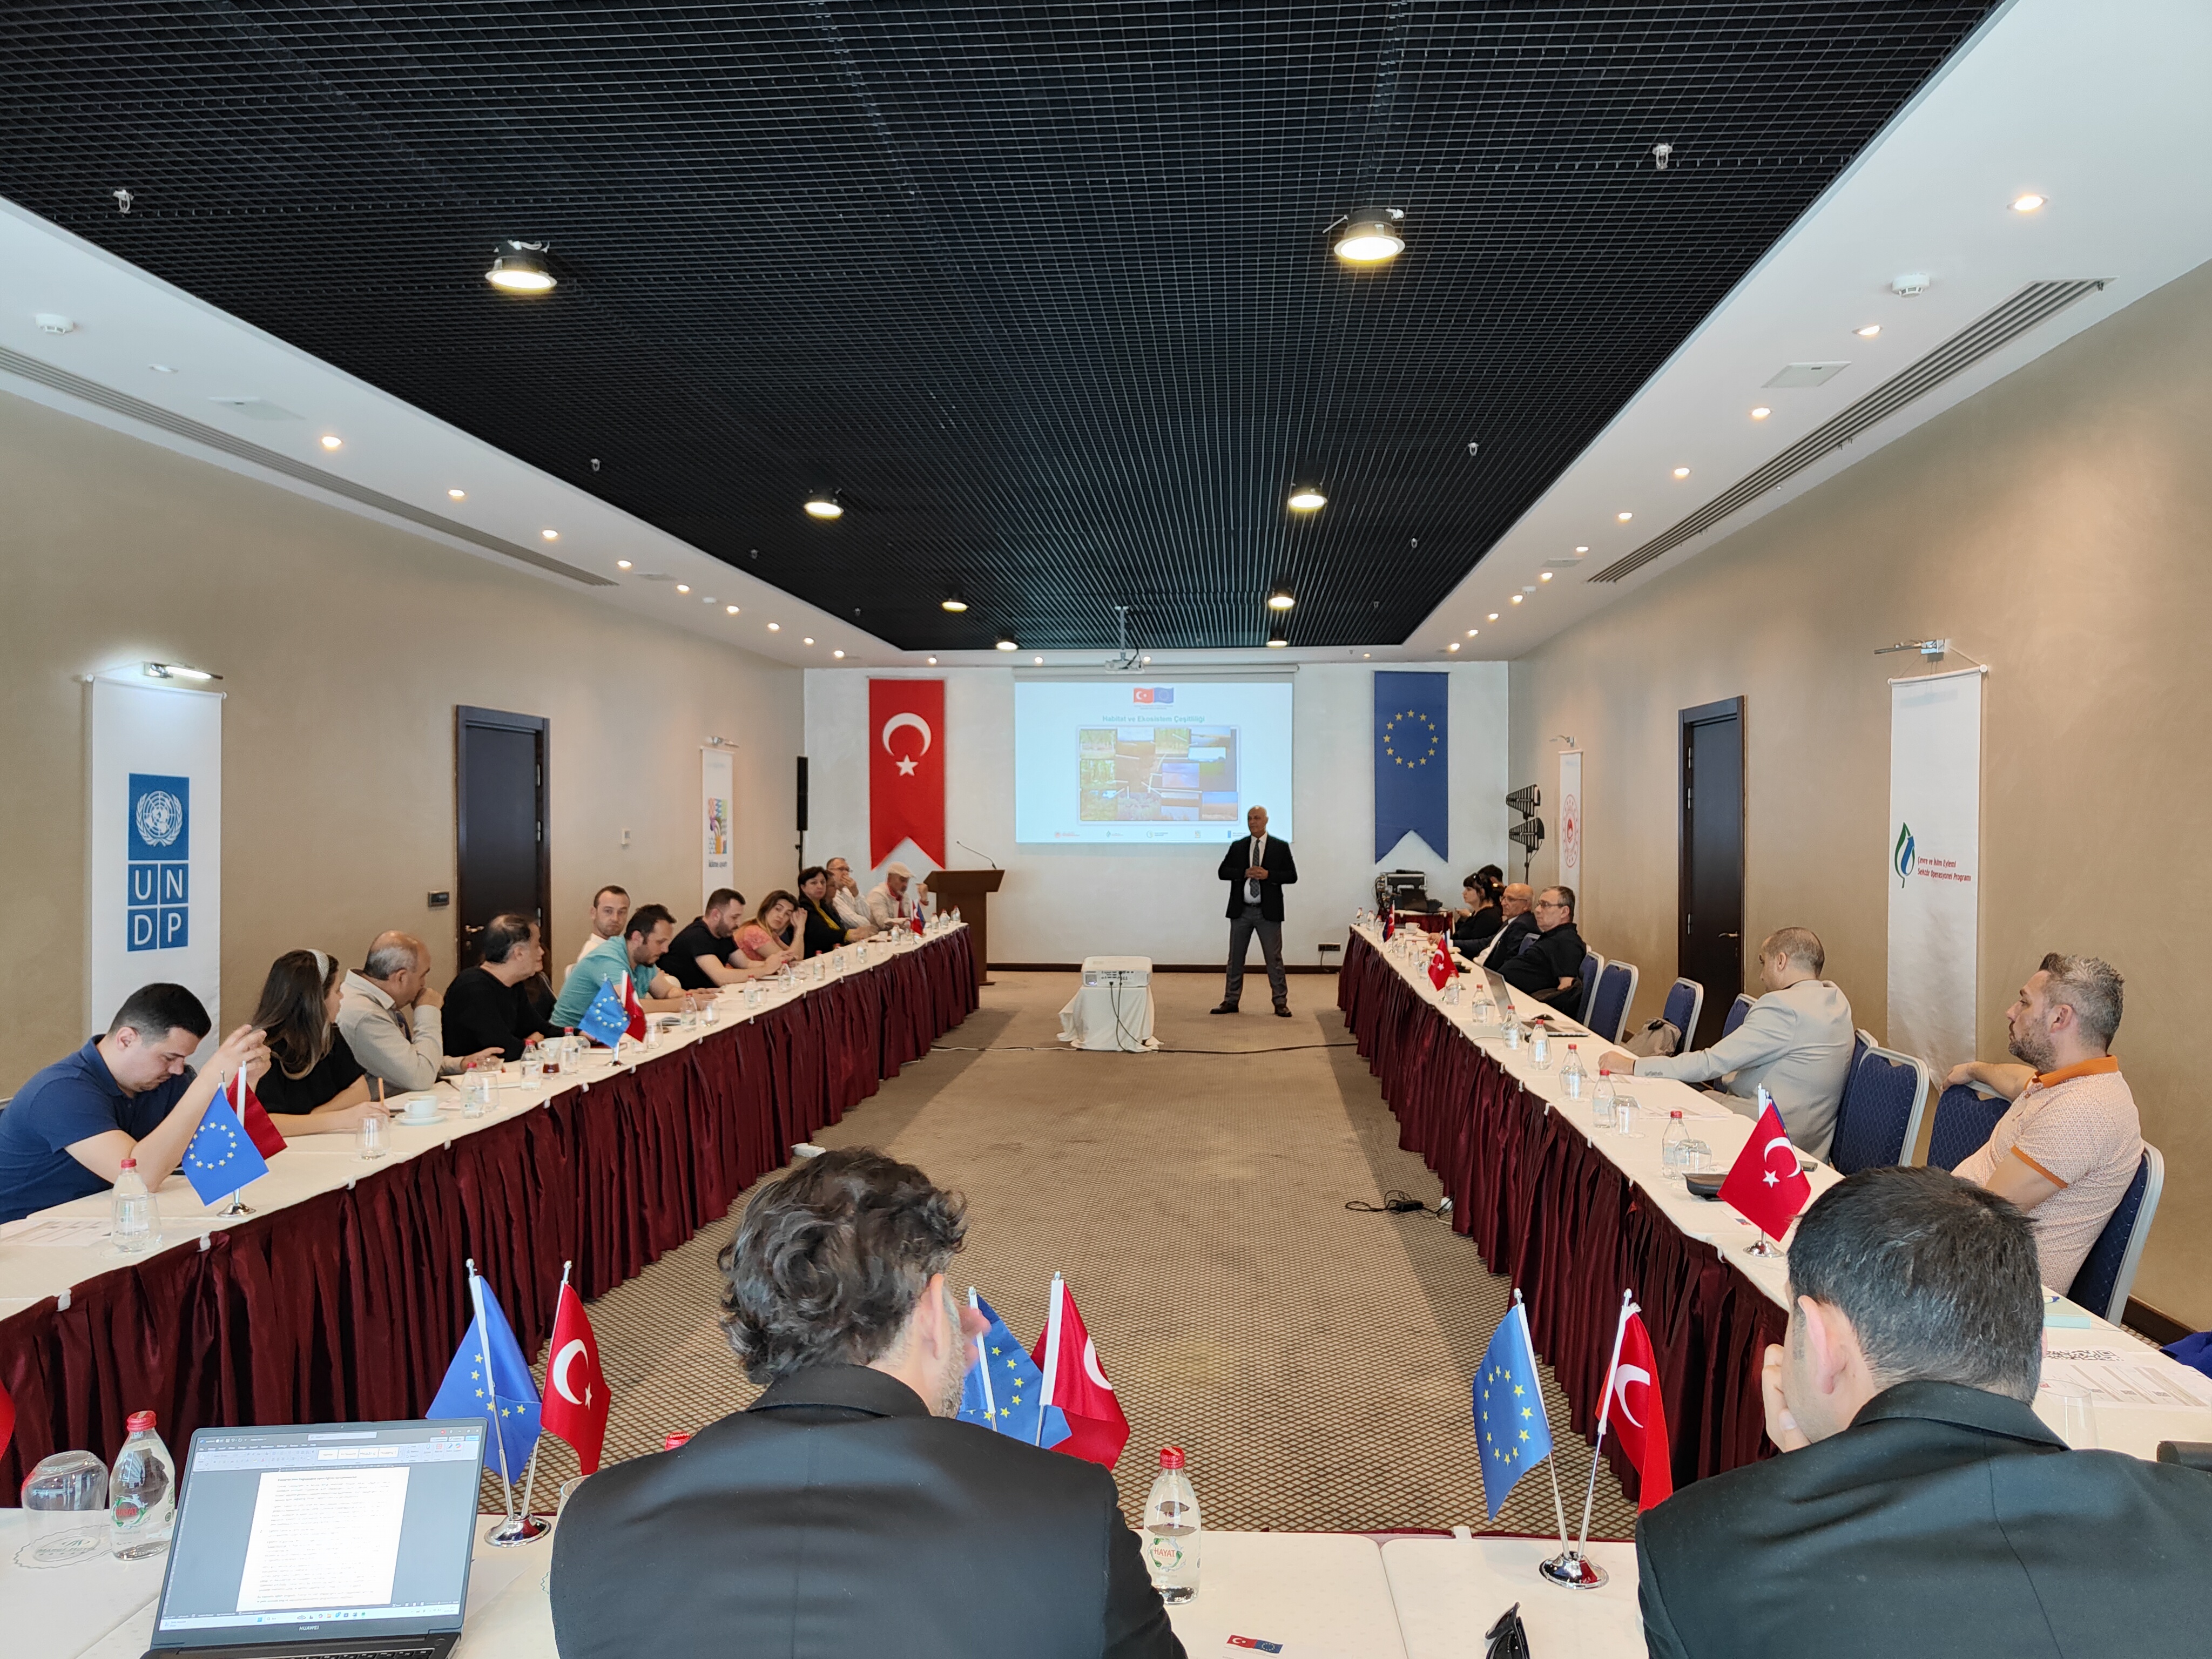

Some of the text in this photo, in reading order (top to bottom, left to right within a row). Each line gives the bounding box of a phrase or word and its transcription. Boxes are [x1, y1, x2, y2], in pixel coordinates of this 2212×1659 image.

[1918, 856, 1928, 865] Çevre
[1918, 868, 1971, 882] Sektör Operasyonel Programı
[1154, 1547, 1176, 1557] HAYAT
